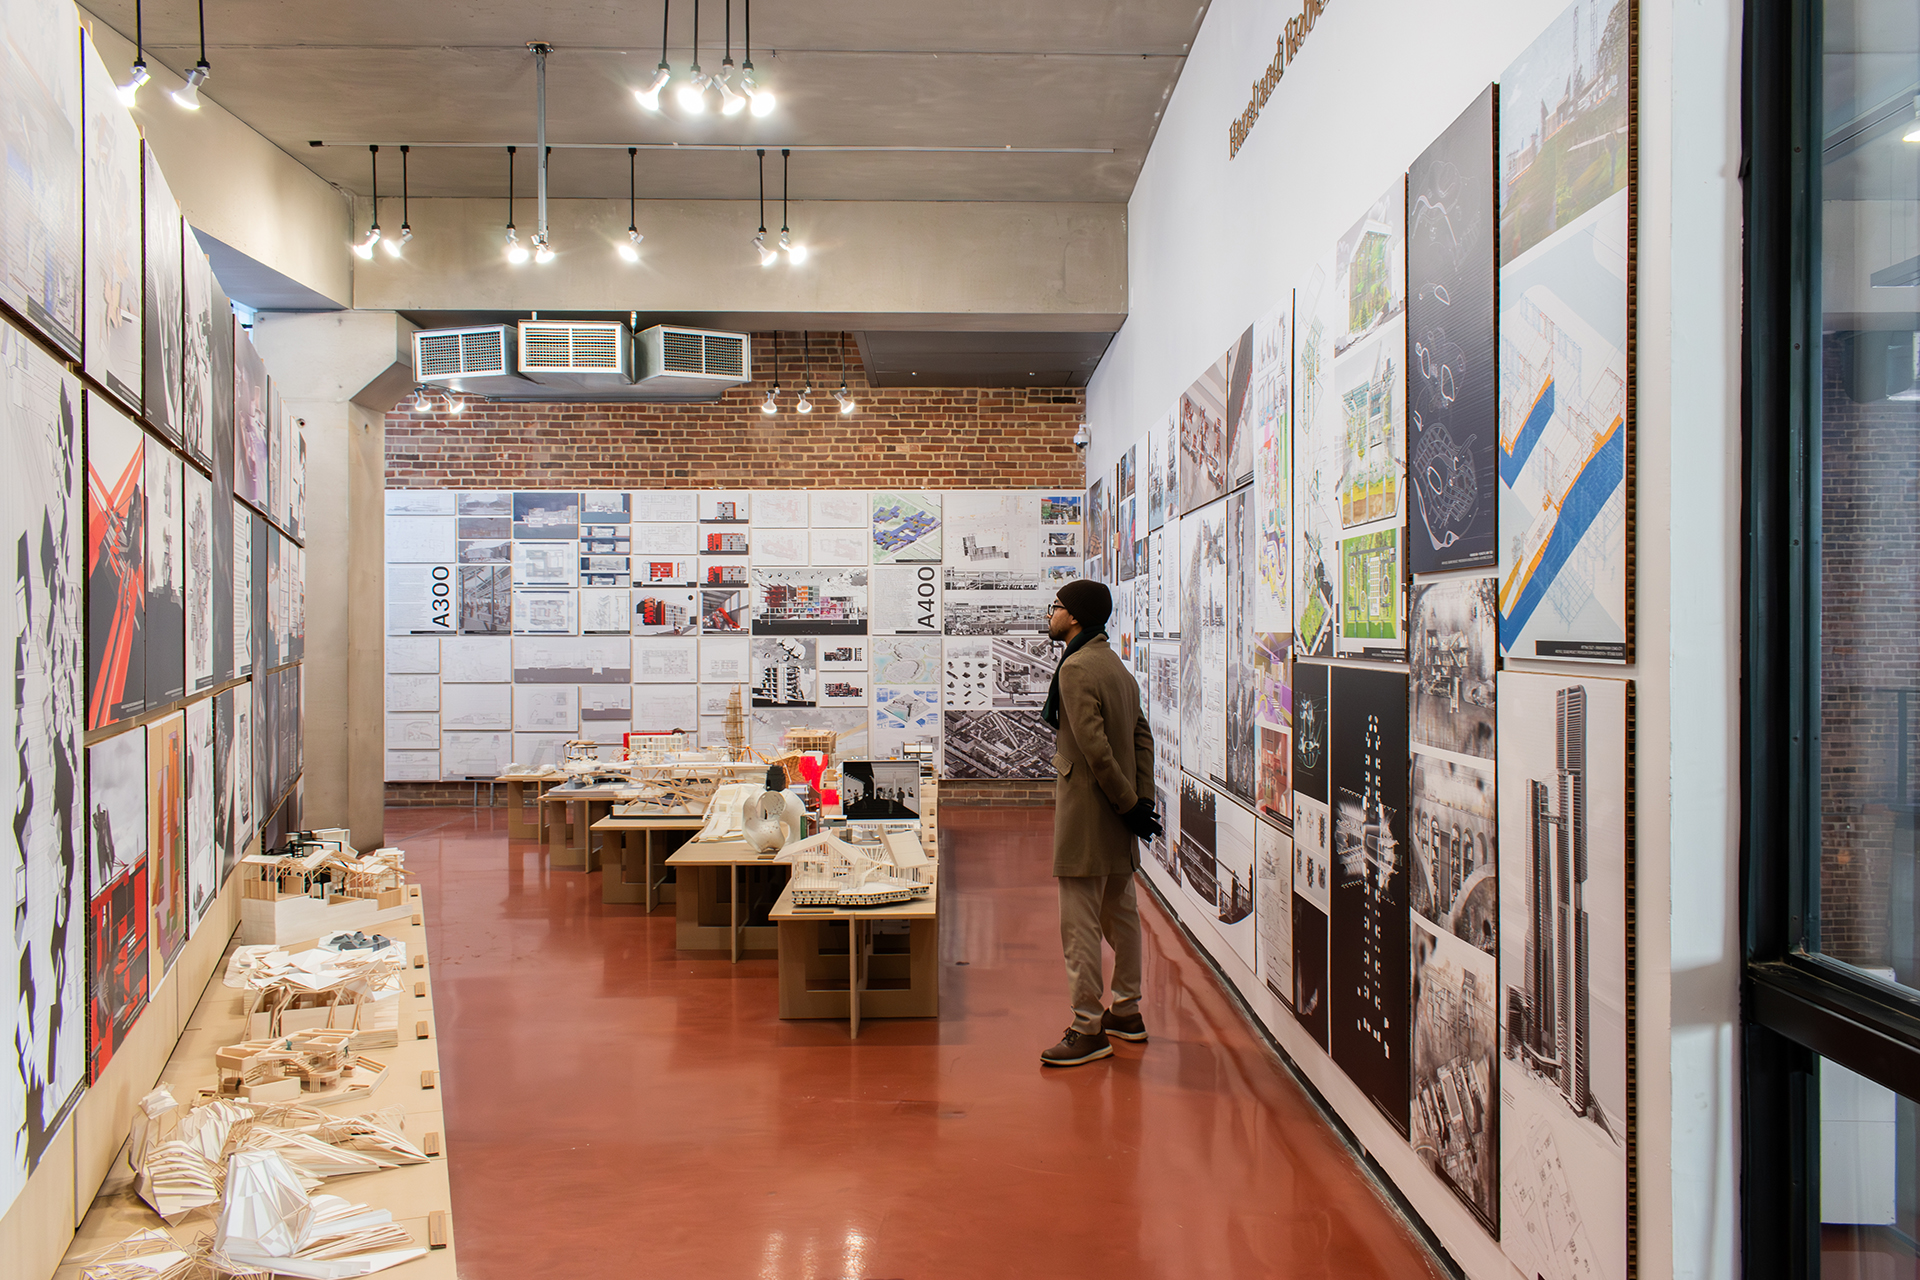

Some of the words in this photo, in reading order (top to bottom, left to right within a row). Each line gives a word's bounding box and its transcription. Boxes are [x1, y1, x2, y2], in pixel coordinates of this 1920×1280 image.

[1259, 34, 1284, 110] and
[432, 566, 450, 628] A300
[917, 567, 935, 628] A400
